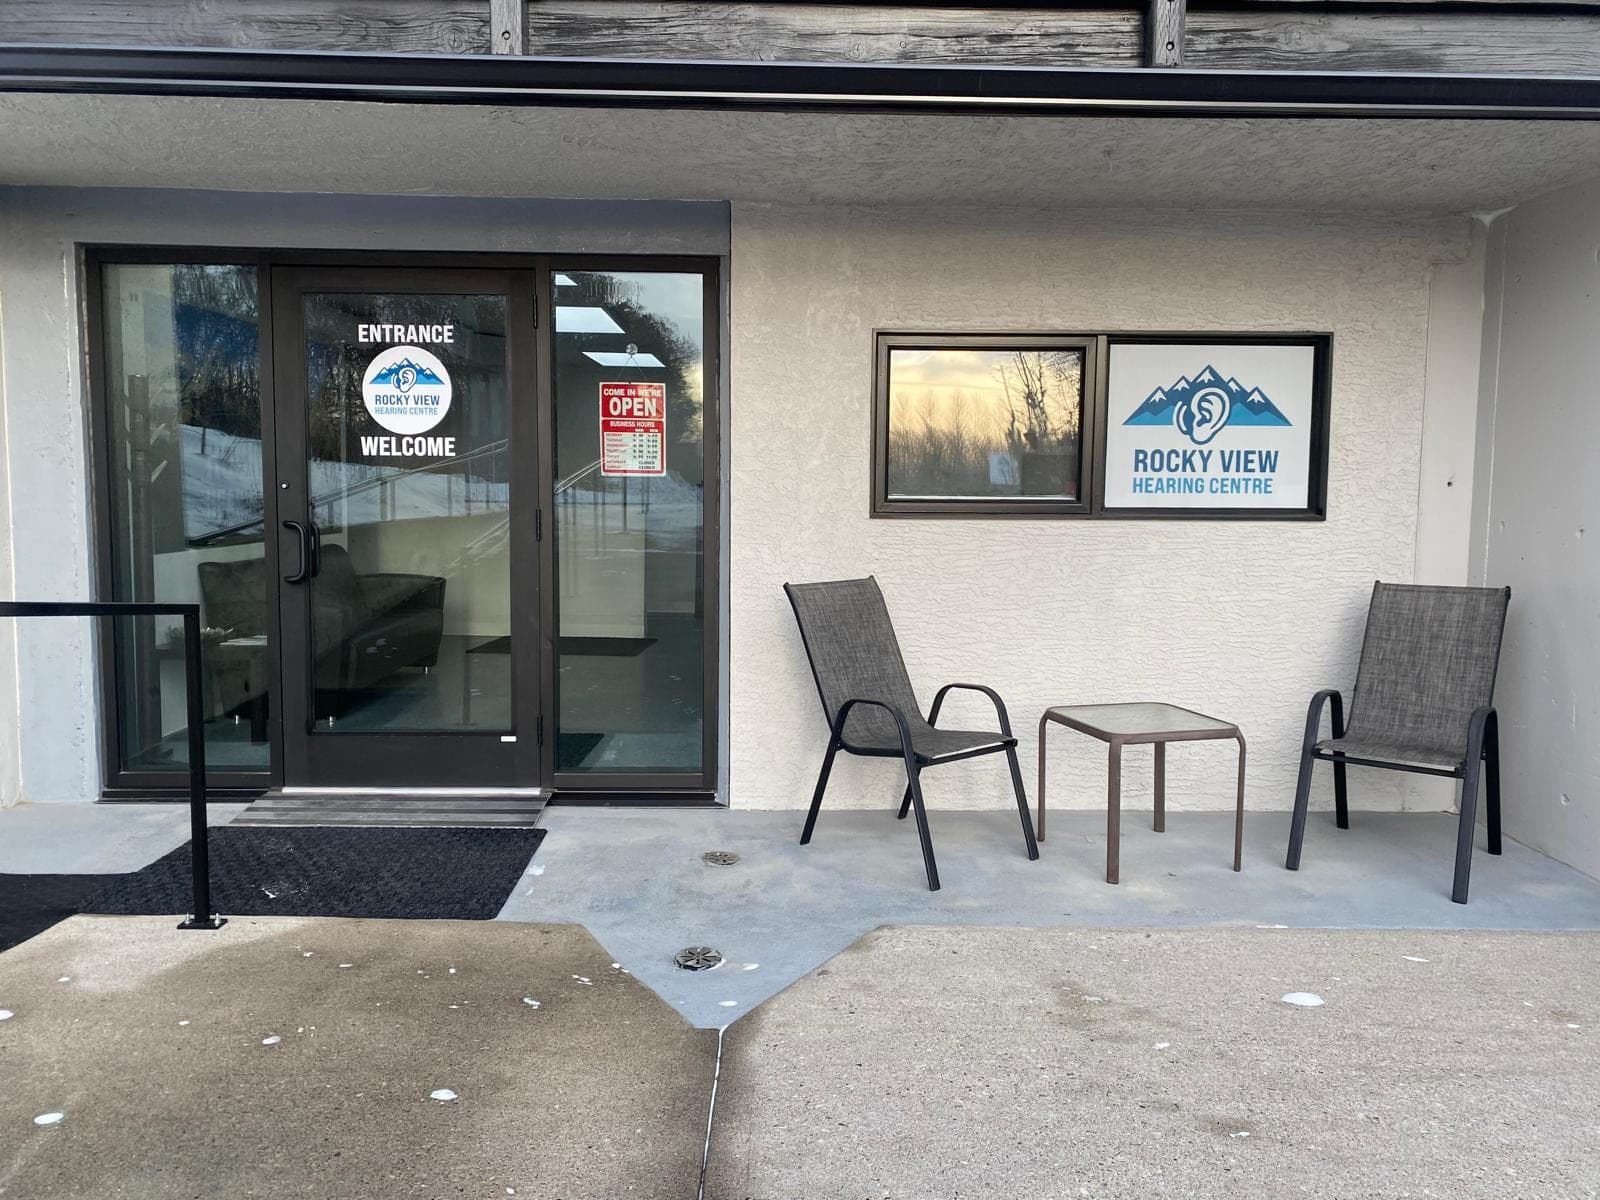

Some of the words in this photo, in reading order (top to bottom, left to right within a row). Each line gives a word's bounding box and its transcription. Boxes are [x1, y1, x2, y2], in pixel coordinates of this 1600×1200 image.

[358, 324, 454, 343] ENTRANCE
[375, 395, 410, 405] ROCKY
[413, 395, 440, 405] VIEW
[603, 388, 626, 396] COME
[627, 388, 636, 396] IN
[638, 389, 662, 397] WE'RE
[374, 407, 408, 415] HEARING
[409, 407, 438, 415] CENTRE
[609, 397, 657, 416] OPEN
[360, 436, 456, 456] WELCOME
[1134, 449, 1213, 473] ROCKY
[1220, 450, 1279, 473] VIEW
[1133, 477, 1204, 494] HEARING
[1209, 478, 1273, 494] CENTRE
